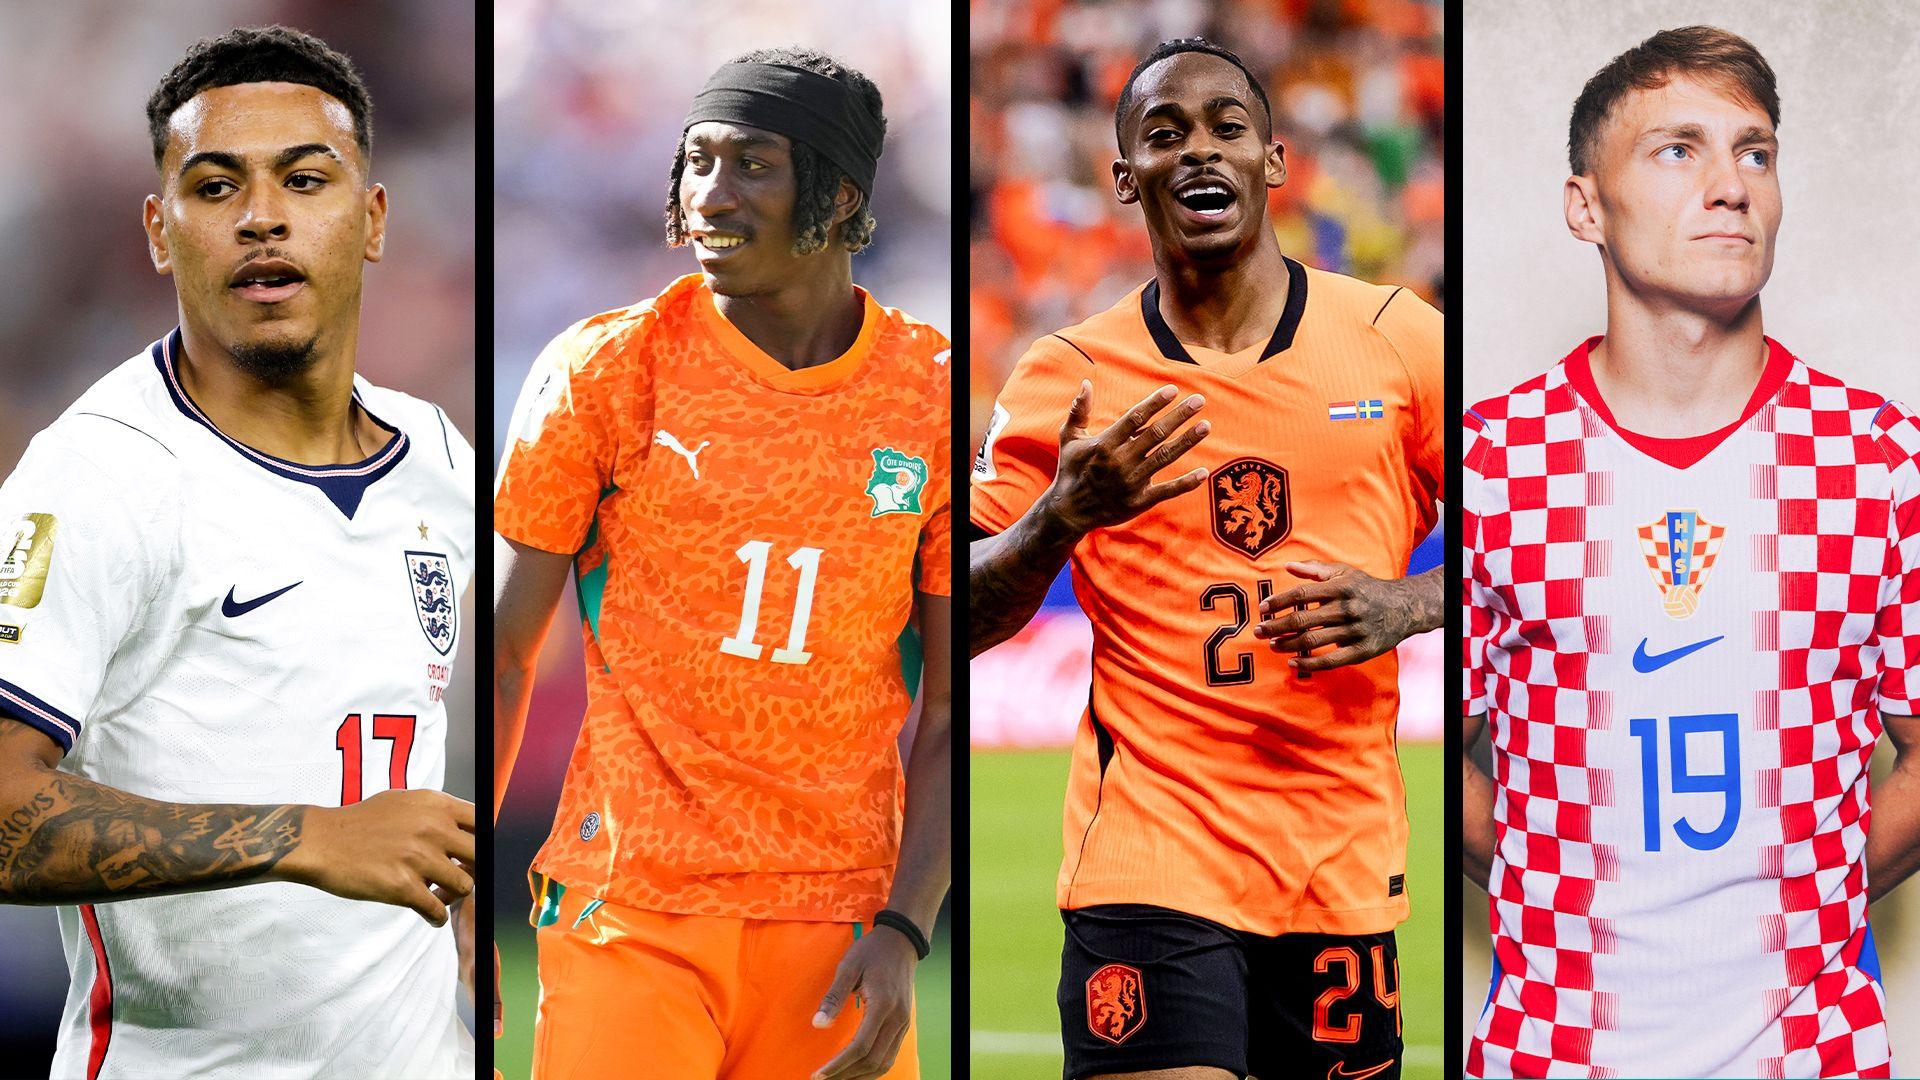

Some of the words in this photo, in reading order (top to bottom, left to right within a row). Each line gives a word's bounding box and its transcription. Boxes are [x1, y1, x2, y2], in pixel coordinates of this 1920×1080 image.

[1674, 519, 1689, 574] HNS
[719, 540, 825, 665] 11
[336, 714, 416, 806] 17
[1629, 713, 1742, 852] 19
[1313, 946, 1401, 1043] 24
